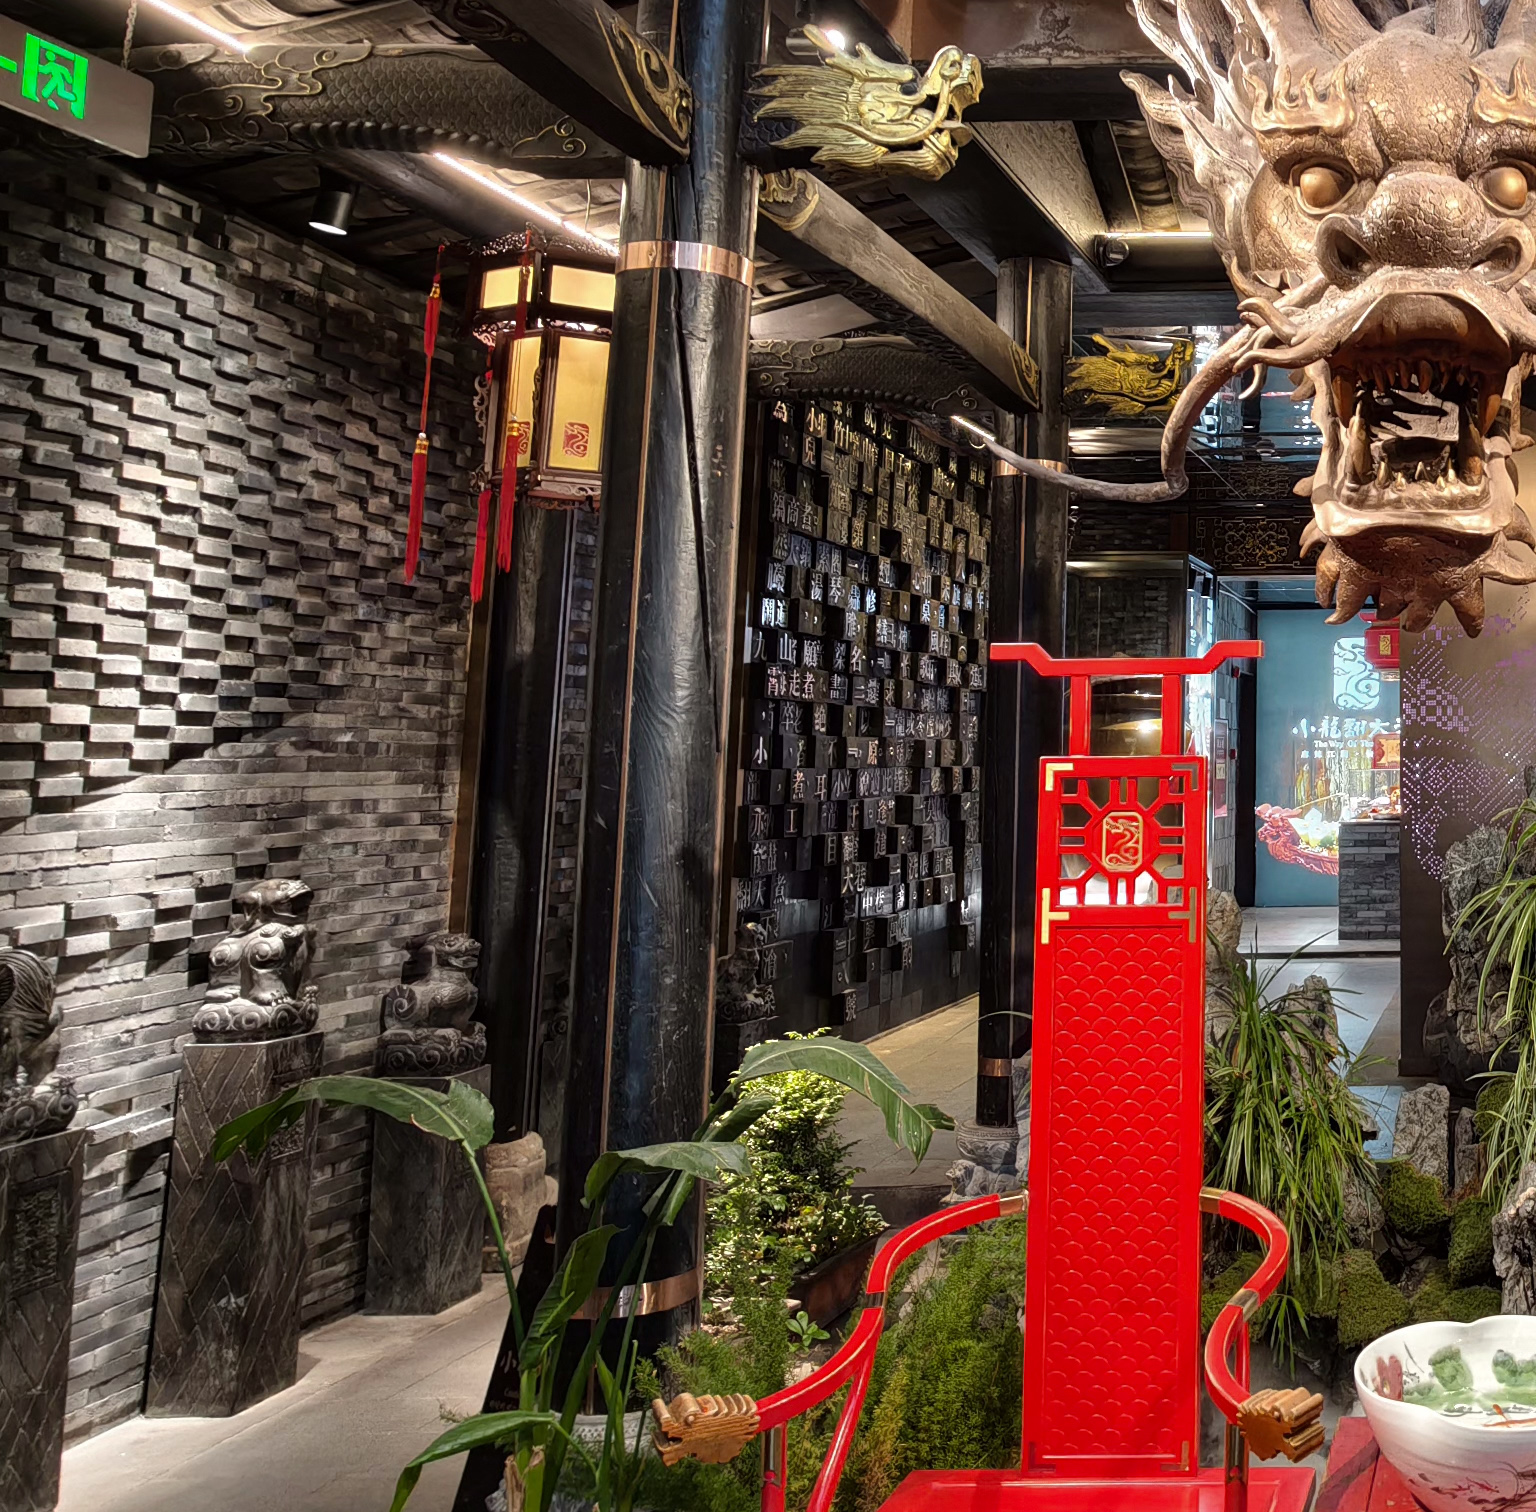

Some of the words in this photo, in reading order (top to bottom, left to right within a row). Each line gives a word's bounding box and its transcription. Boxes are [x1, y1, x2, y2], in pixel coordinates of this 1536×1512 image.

[754, 631, 767, 661] 九
[780, 633, 791, 661] 山
[851, 646, 862, 672] 名
[801, 671, 815, 699] 煮
[753, 736, 768, 765] 小
[786, 807, 798, 833] 工
[841, 866, 854, 894] 大
